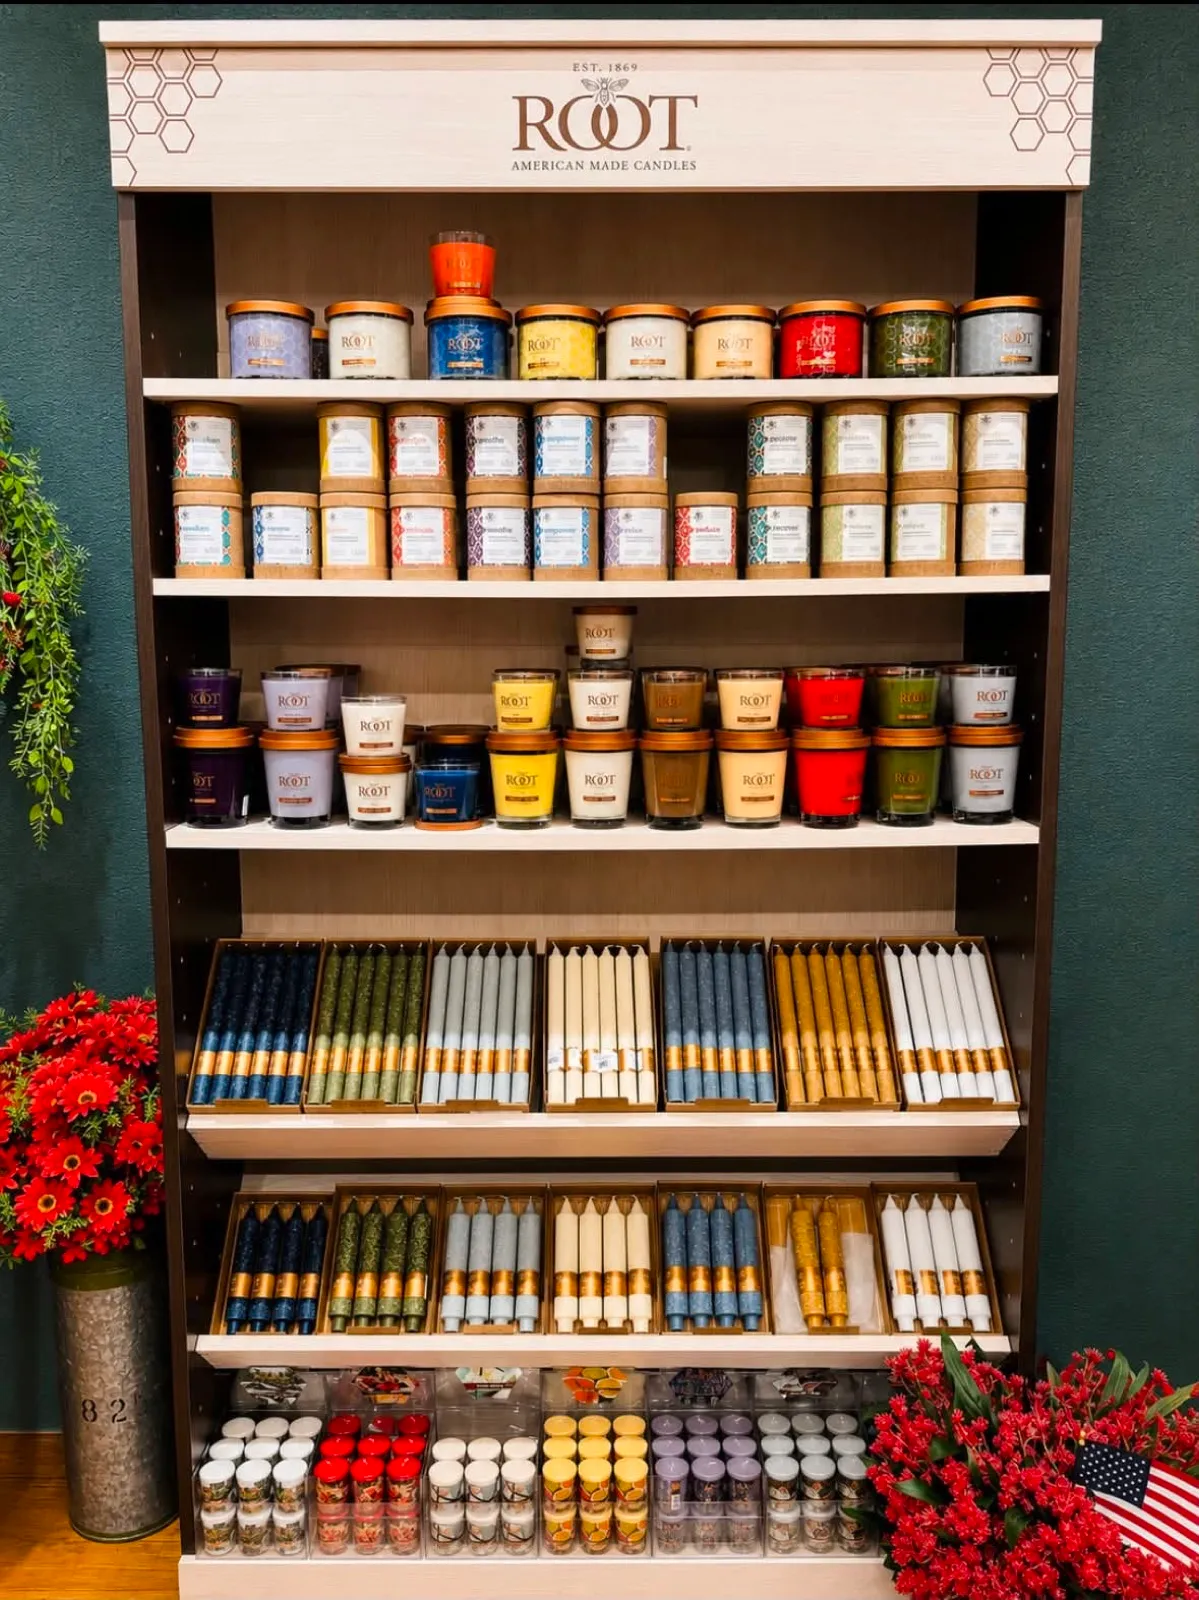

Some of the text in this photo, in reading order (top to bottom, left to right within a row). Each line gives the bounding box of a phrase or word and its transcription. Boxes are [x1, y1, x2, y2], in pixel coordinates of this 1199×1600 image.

[573, 63, 638, 73] EST. 1869
[512, 95, 698, 151] ROOT
[511, 160, 697, 171] AMERICAN MADE CANDLES
[341, 335, 375, 349] ROOT
[528, 338, 559, 352] ROOT
[630, 337, 665, 349] ROOT
[718, 338, 753, 350] ROOT
[586, 628, 615, 638] ROOT
[278, 695, 311, 706] ROOT
[501, 696, 531, 706] ROOT
[588, 695, 618, 706] ROOT
[740, 695, 771, 706] ROOT
[977, 690, 1009, 701] ROOT
[360, 720, 393, 731] ROOT
[970, 768, 1004, 780] ROOT
[279, 775, 311, 787] ROOT
[506, 775, 538, 786] ROOT
[585, 774, 616, 786] ROOT
[743, 774, 775, 786] ROOT
[358, 785, 391, 797] ROOT
